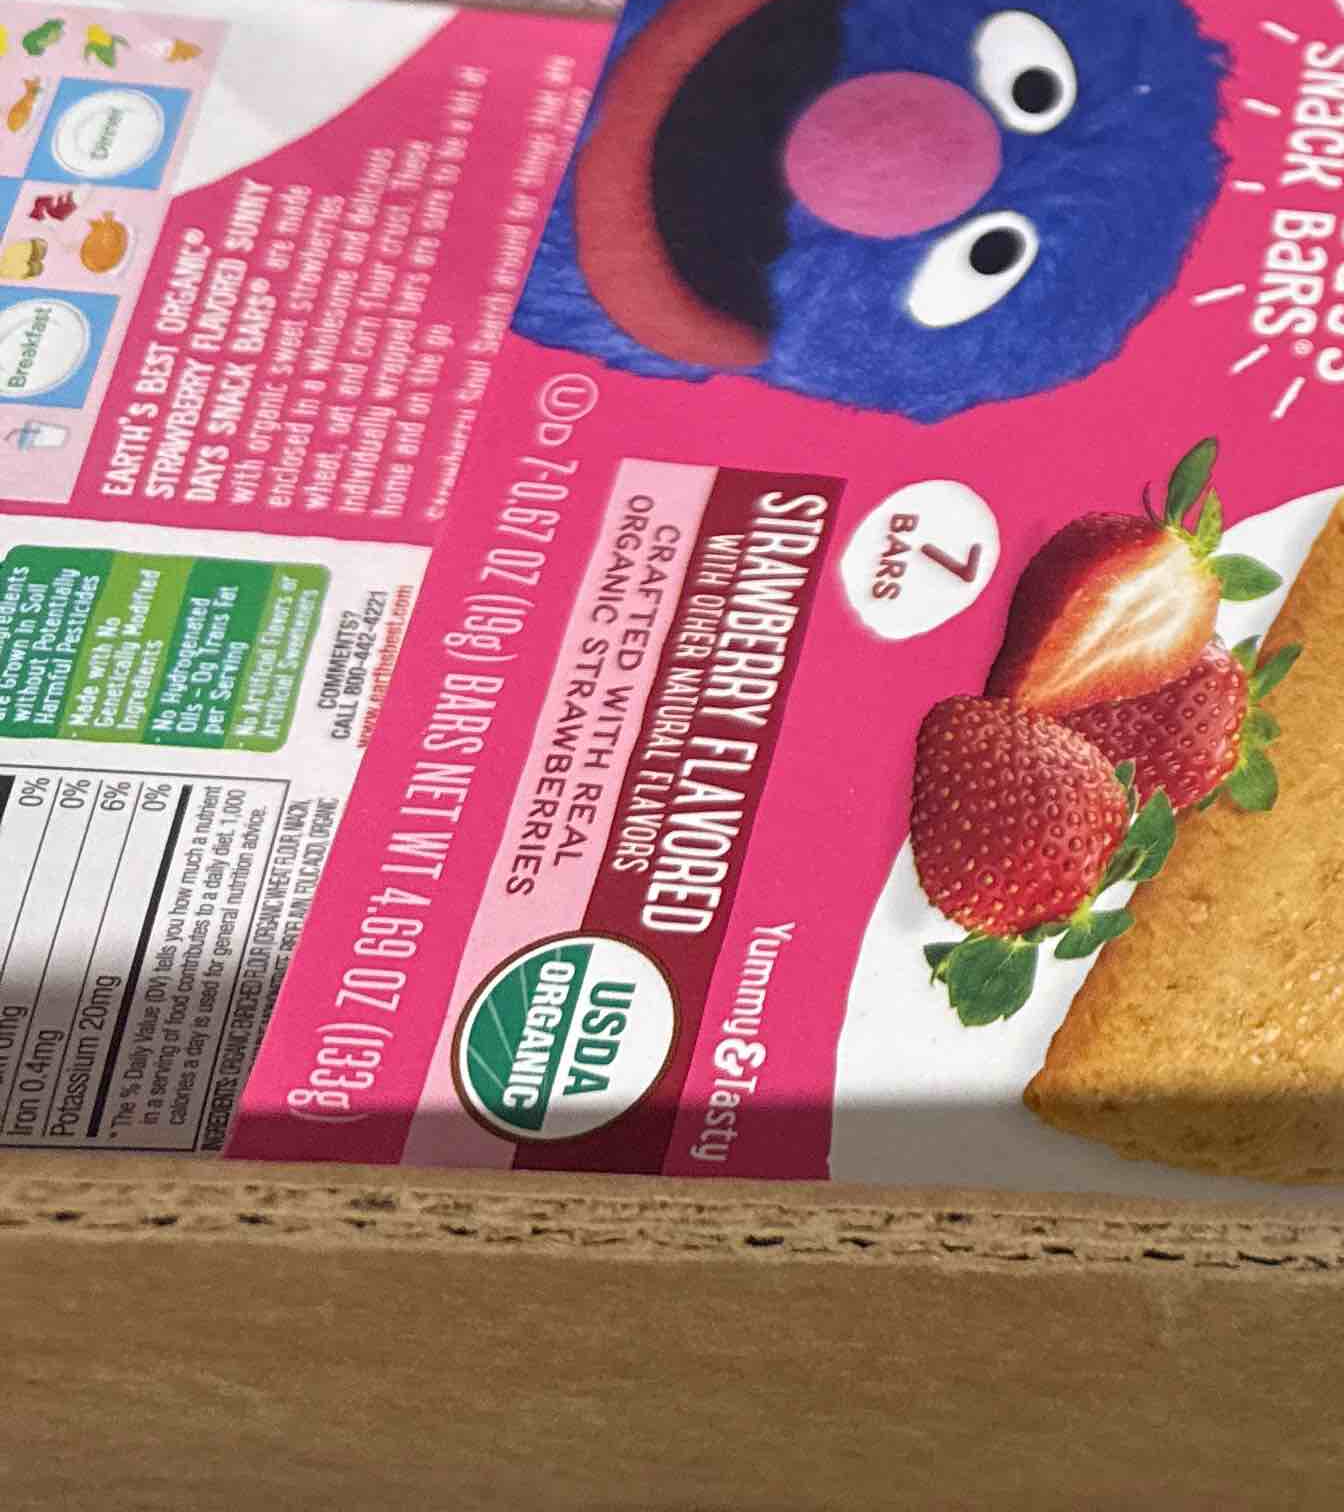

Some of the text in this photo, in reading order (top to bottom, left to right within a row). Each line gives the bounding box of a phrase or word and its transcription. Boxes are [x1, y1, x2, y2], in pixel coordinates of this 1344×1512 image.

[145, 177, 272, 501] STRAWBERRY FLAVORED SUNNY
[101, 402, 160, 497] EARTH'S
[135, 340, 179, 395] BEST
[480, 547, 546, 585] OZ
[871, 512, 920, 601] BARS
[920, 543, 982, 583] 7
[316, 609, 359, 710] COMMENTS?
[330, 589, 387, 740] CALL 800-442-4221
[441, 590, 537, 663] (19g)
[419, 673, 504, 753] BARS
[504, 492, 654, 896] ORGANIC STRAWBERRIES
[551, 523, 682, 867] CRAFTED WITH REAL
[611, 534, 746, 872] WITH OTHER NATURAL FLAVORS
[639, 491, 830, 932] STRAWBERRY FLAVORED
[401, 764, 476, 822] NET
[386, 832, 445, 881] WT
[357, 884, 430, 957] 4.69
[335, 967, 409, 1012] OZ
[724, 920, 797, 1034] Yummy
[52, 974, 122, 1138] Potassium 20mg
[500, 959, 575, 1110] ORGANIC
[561, 979, 638, 1094] USDA
[687, 1077, 746, 1163] Tasty
